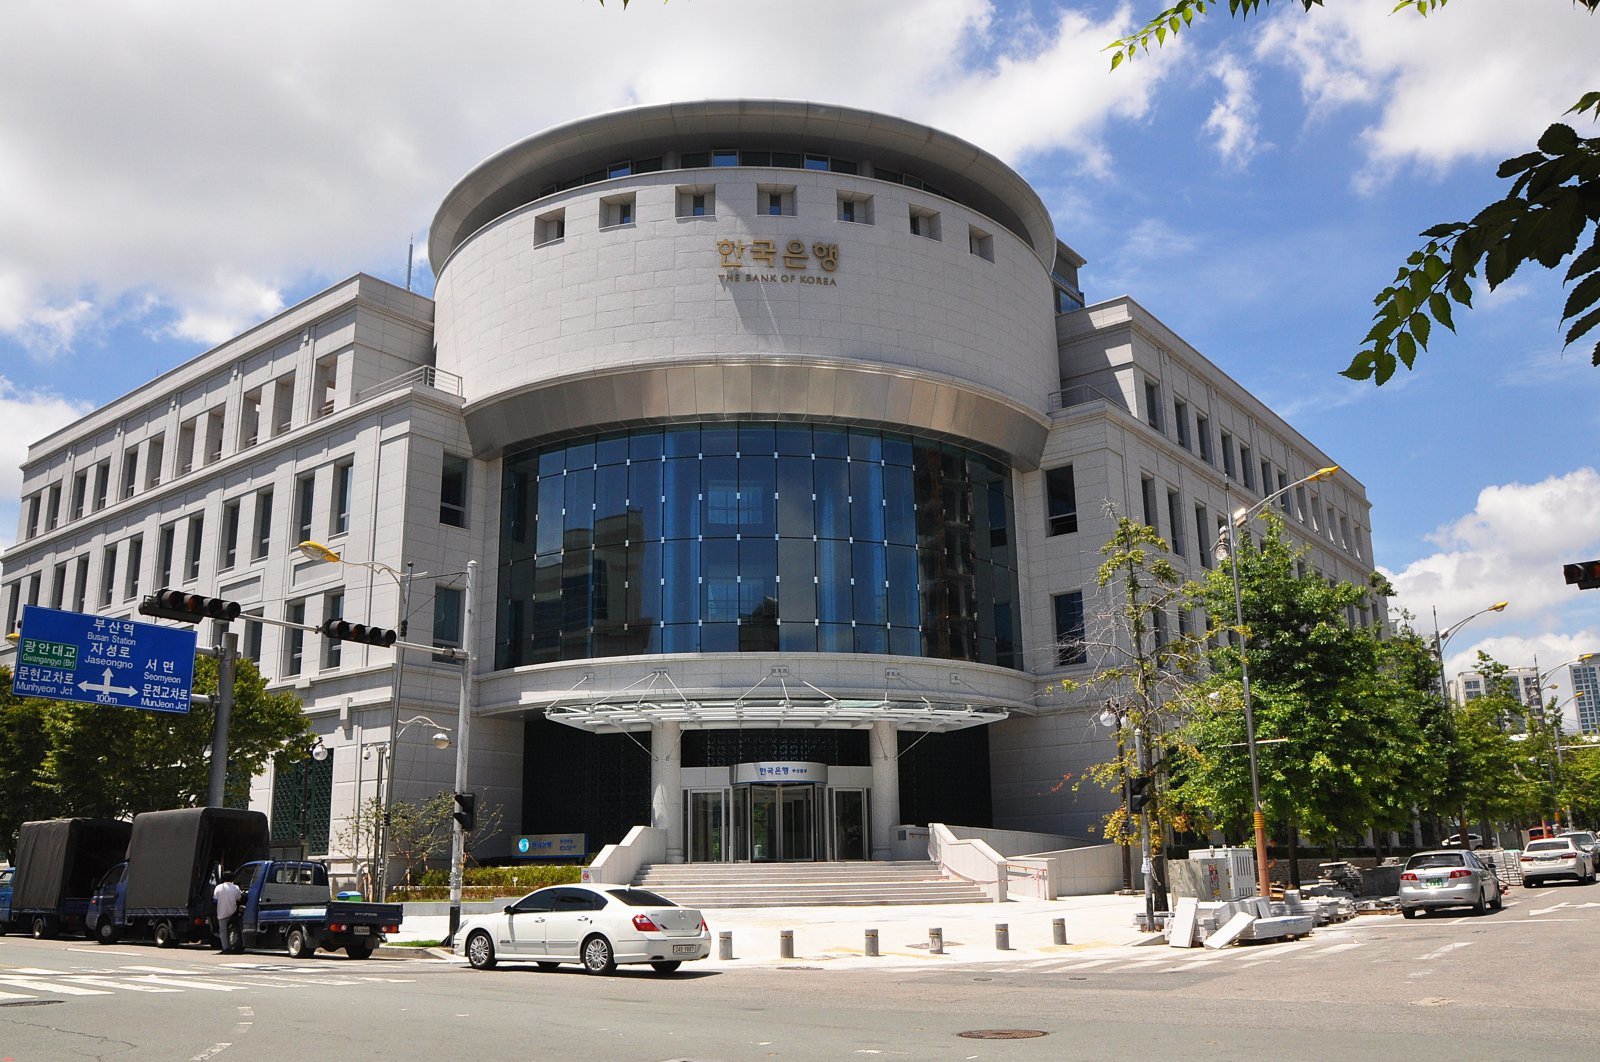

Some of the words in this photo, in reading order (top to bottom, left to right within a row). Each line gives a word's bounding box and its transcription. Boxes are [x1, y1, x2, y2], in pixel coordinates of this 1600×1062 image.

[717, 239, 839, 272] 한국은행
[718, 274, 740, 283] THE
[745, 274, 777, 283] BANK
[781, 274, 796, 283] OF
[800, 275, 838, 286] KOREA
[93, 618, 134, 637] 부산역
[87, 631, 110, 642] Busan
[111, 634, 137, 646] Station
[24, 640, 76, 658] 광안대교
[90, 642, 131, 658] 자성로
[84, 655, 134, 669] Jaseongno
[145, 658, 174, 674] 서면
[18, 666, 74, 685] 문현교차로
[143, 671, 182, 684] Seomyeon
[15, 680, 57, 694] Munhyeon
[60, 686, 73, 696] Jct
[142, 683, 188, 701] 문전교차로
[96, 694, 118, 704] 100m
[175, 701, 187, 711] Jct
[759, 766, 789, 776] 한국은행
